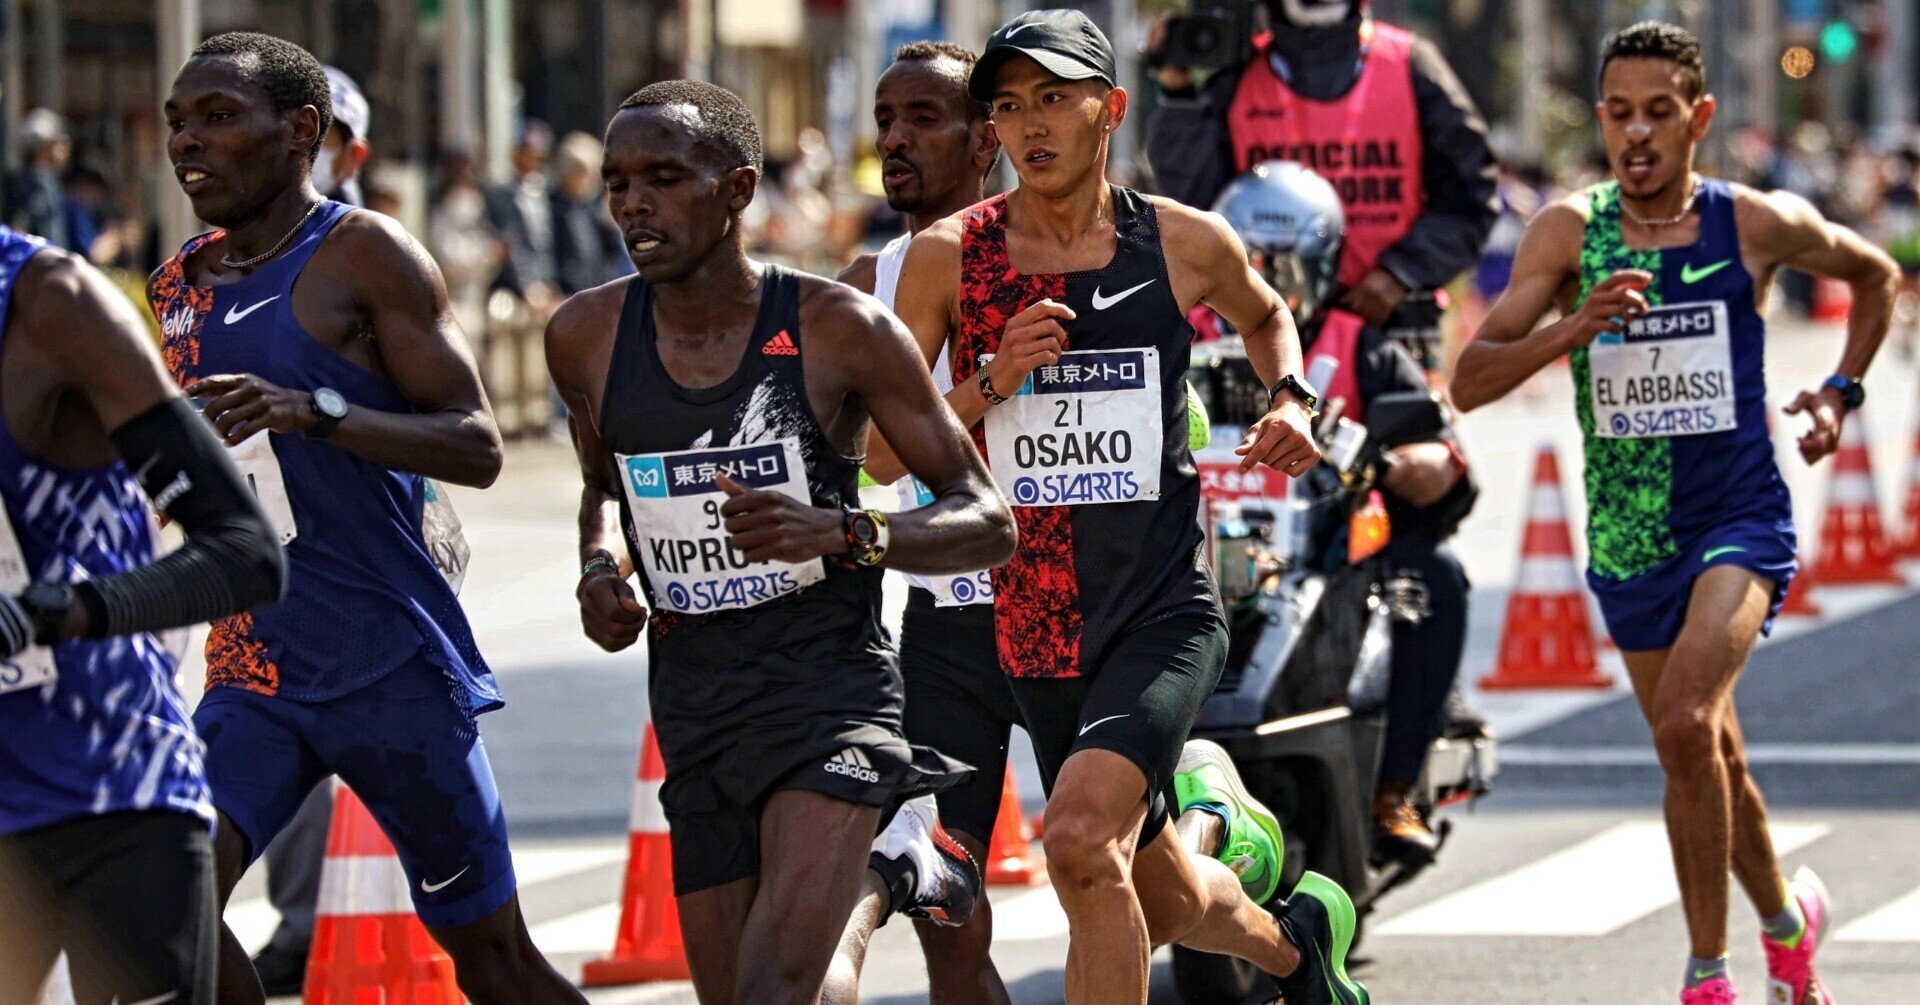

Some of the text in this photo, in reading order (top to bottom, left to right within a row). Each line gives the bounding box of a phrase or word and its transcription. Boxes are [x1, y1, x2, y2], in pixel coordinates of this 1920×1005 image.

[1627, 311, 1711, 337] 東京メトロ
[761, 345, 799, 356] adidas
[1648, 347, 1661, 371] 7
[1040, 362, 1137, 385] 東京メトロ
[1597, 371, 1726, 406] EL ABBASSI
[1053, 399, 1083, 428] 21
[1014, 430, 1132, 469] OSAKO
[672, 455, 779, 487] 東京メトロ
[702, 500, 720, 530] 9
[823, 761, 880, 783] adidas
